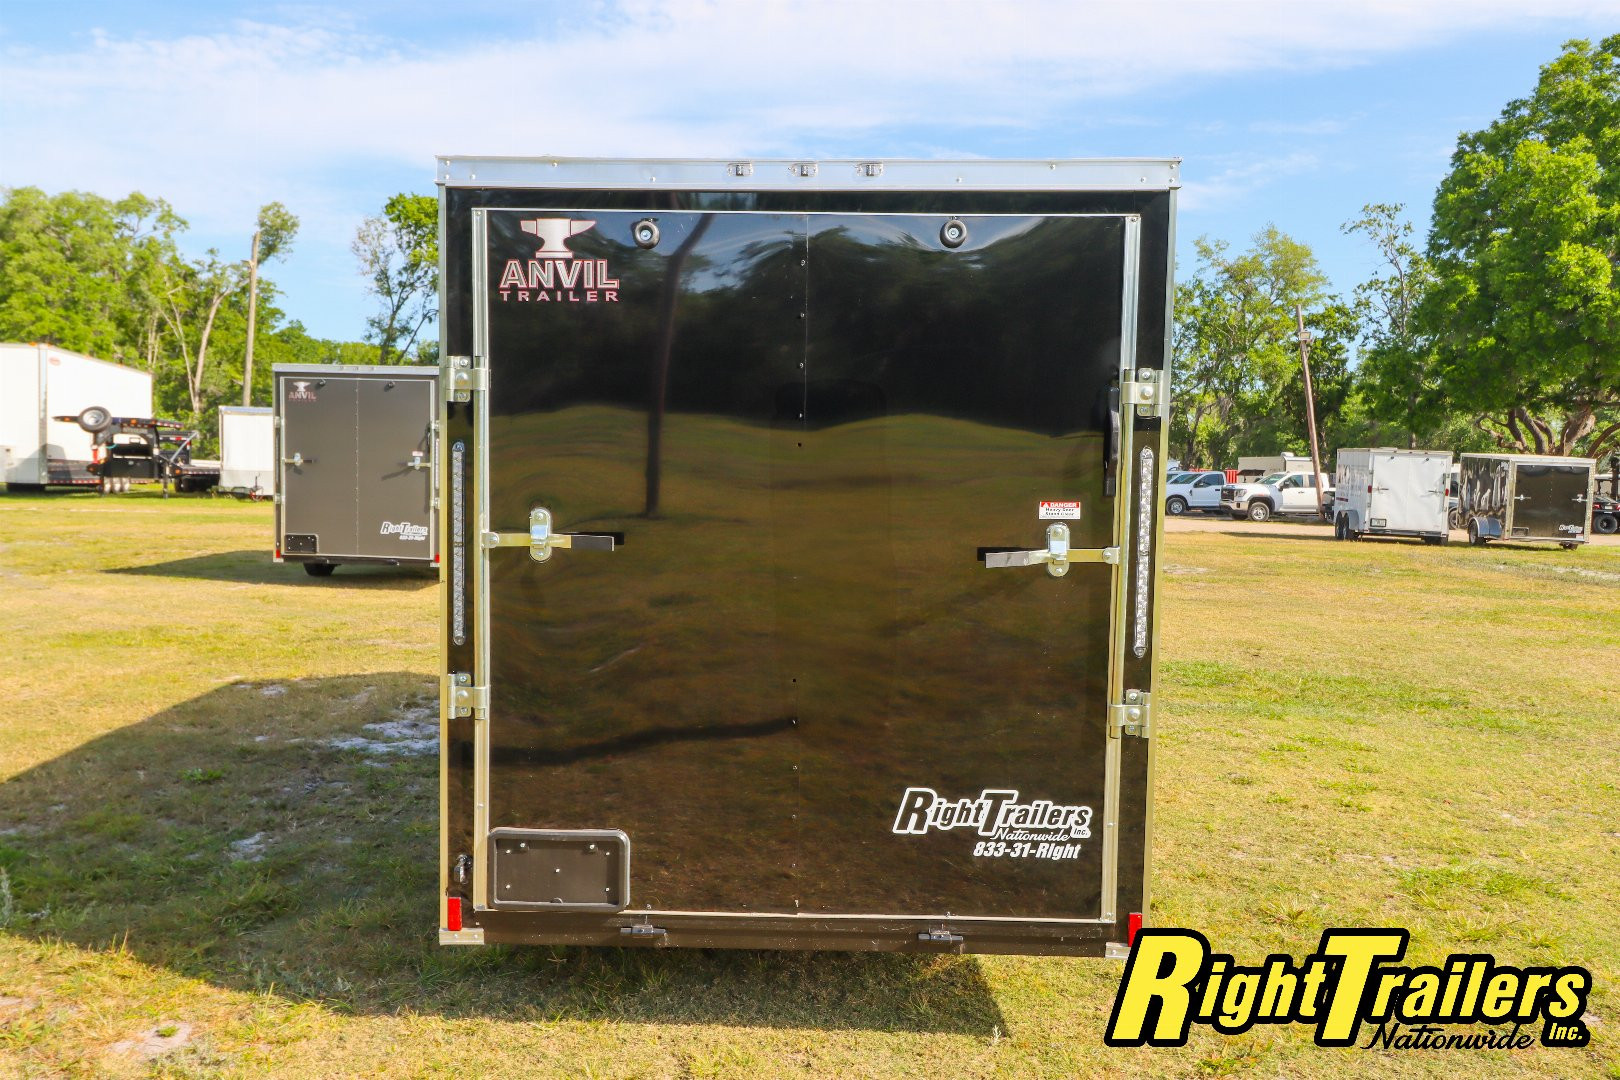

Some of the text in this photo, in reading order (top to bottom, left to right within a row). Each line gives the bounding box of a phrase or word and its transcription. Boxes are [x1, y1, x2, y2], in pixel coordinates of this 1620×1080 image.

[500, 259, 620, 290] ANVIL
[500, 290, 619, 302] TRAILER
[288, 391, 317, 400] ANVIL
[990, 827, 1089, 842] Nationwide Inc.
